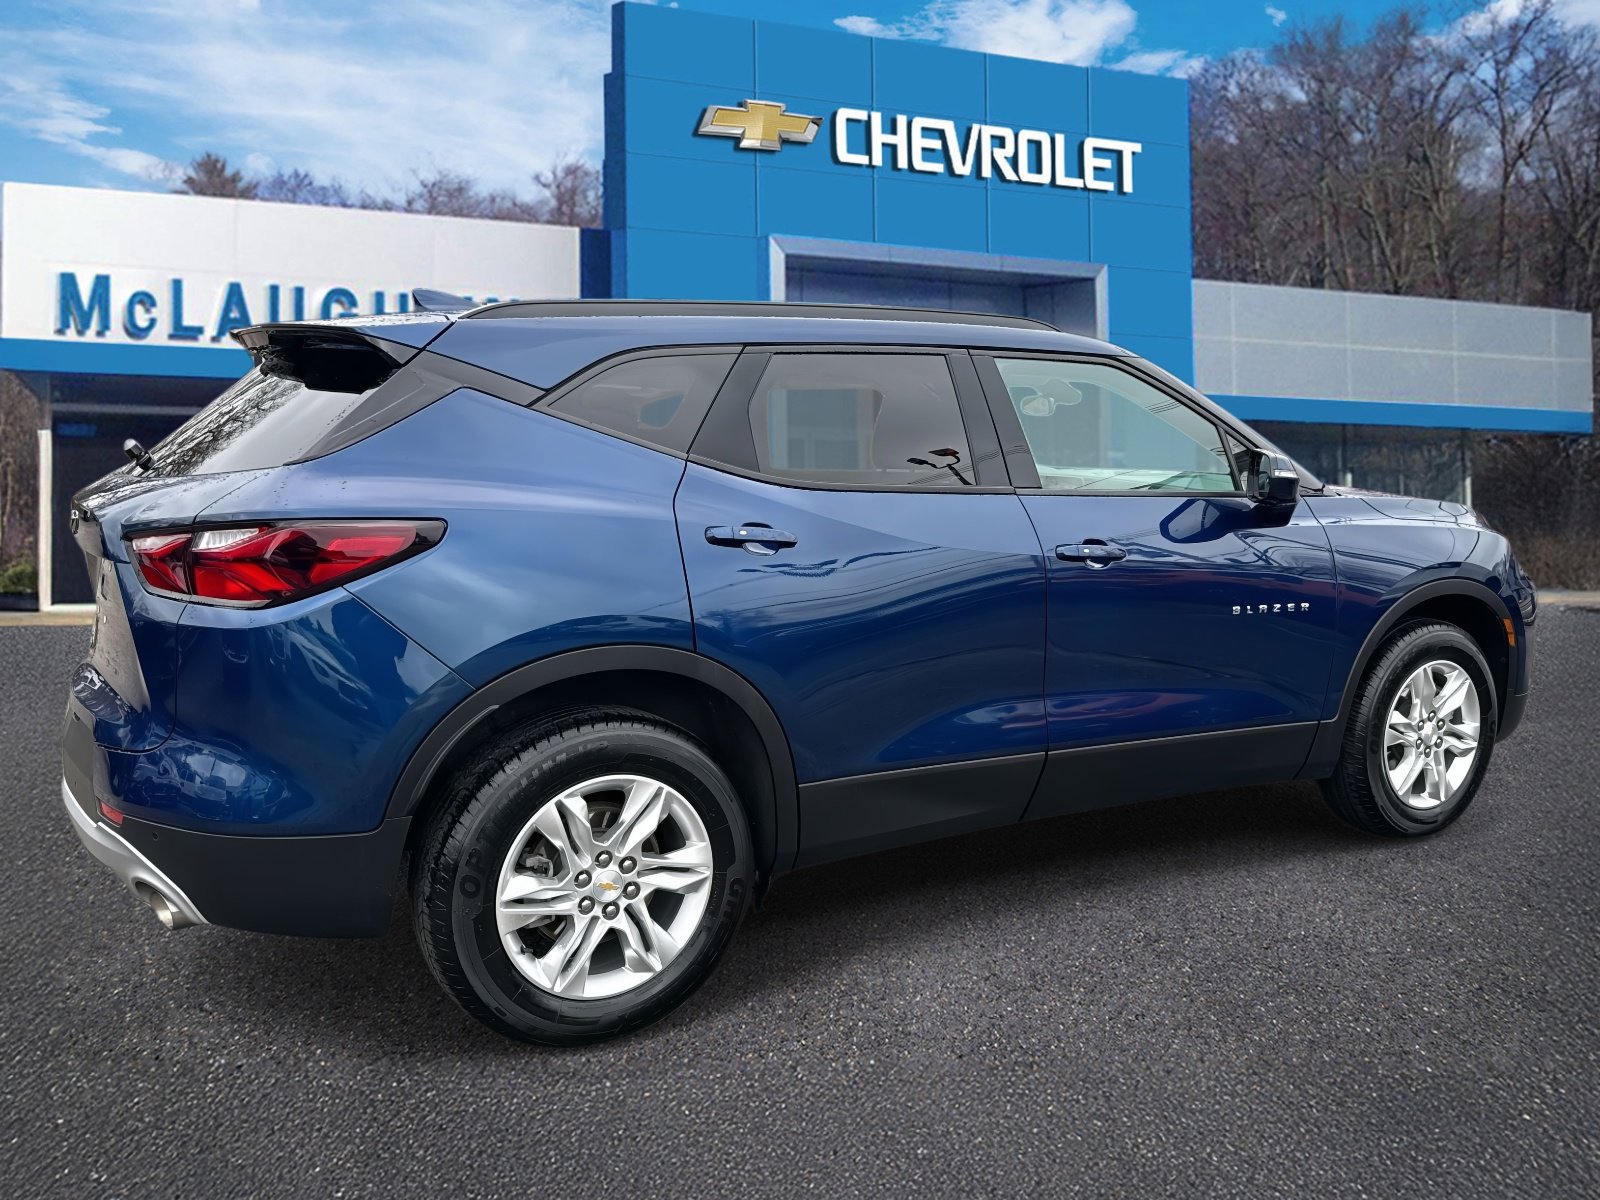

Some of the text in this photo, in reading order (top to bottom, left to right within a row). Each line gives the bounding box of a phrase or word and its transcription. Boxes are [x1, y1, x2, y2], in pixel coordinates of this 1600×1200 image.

[834, 106, 1143, 194] CHEVROLET
[56, 271, 521, 341] McLAUG
[1232, 602, 1310, 615] BLAZER
